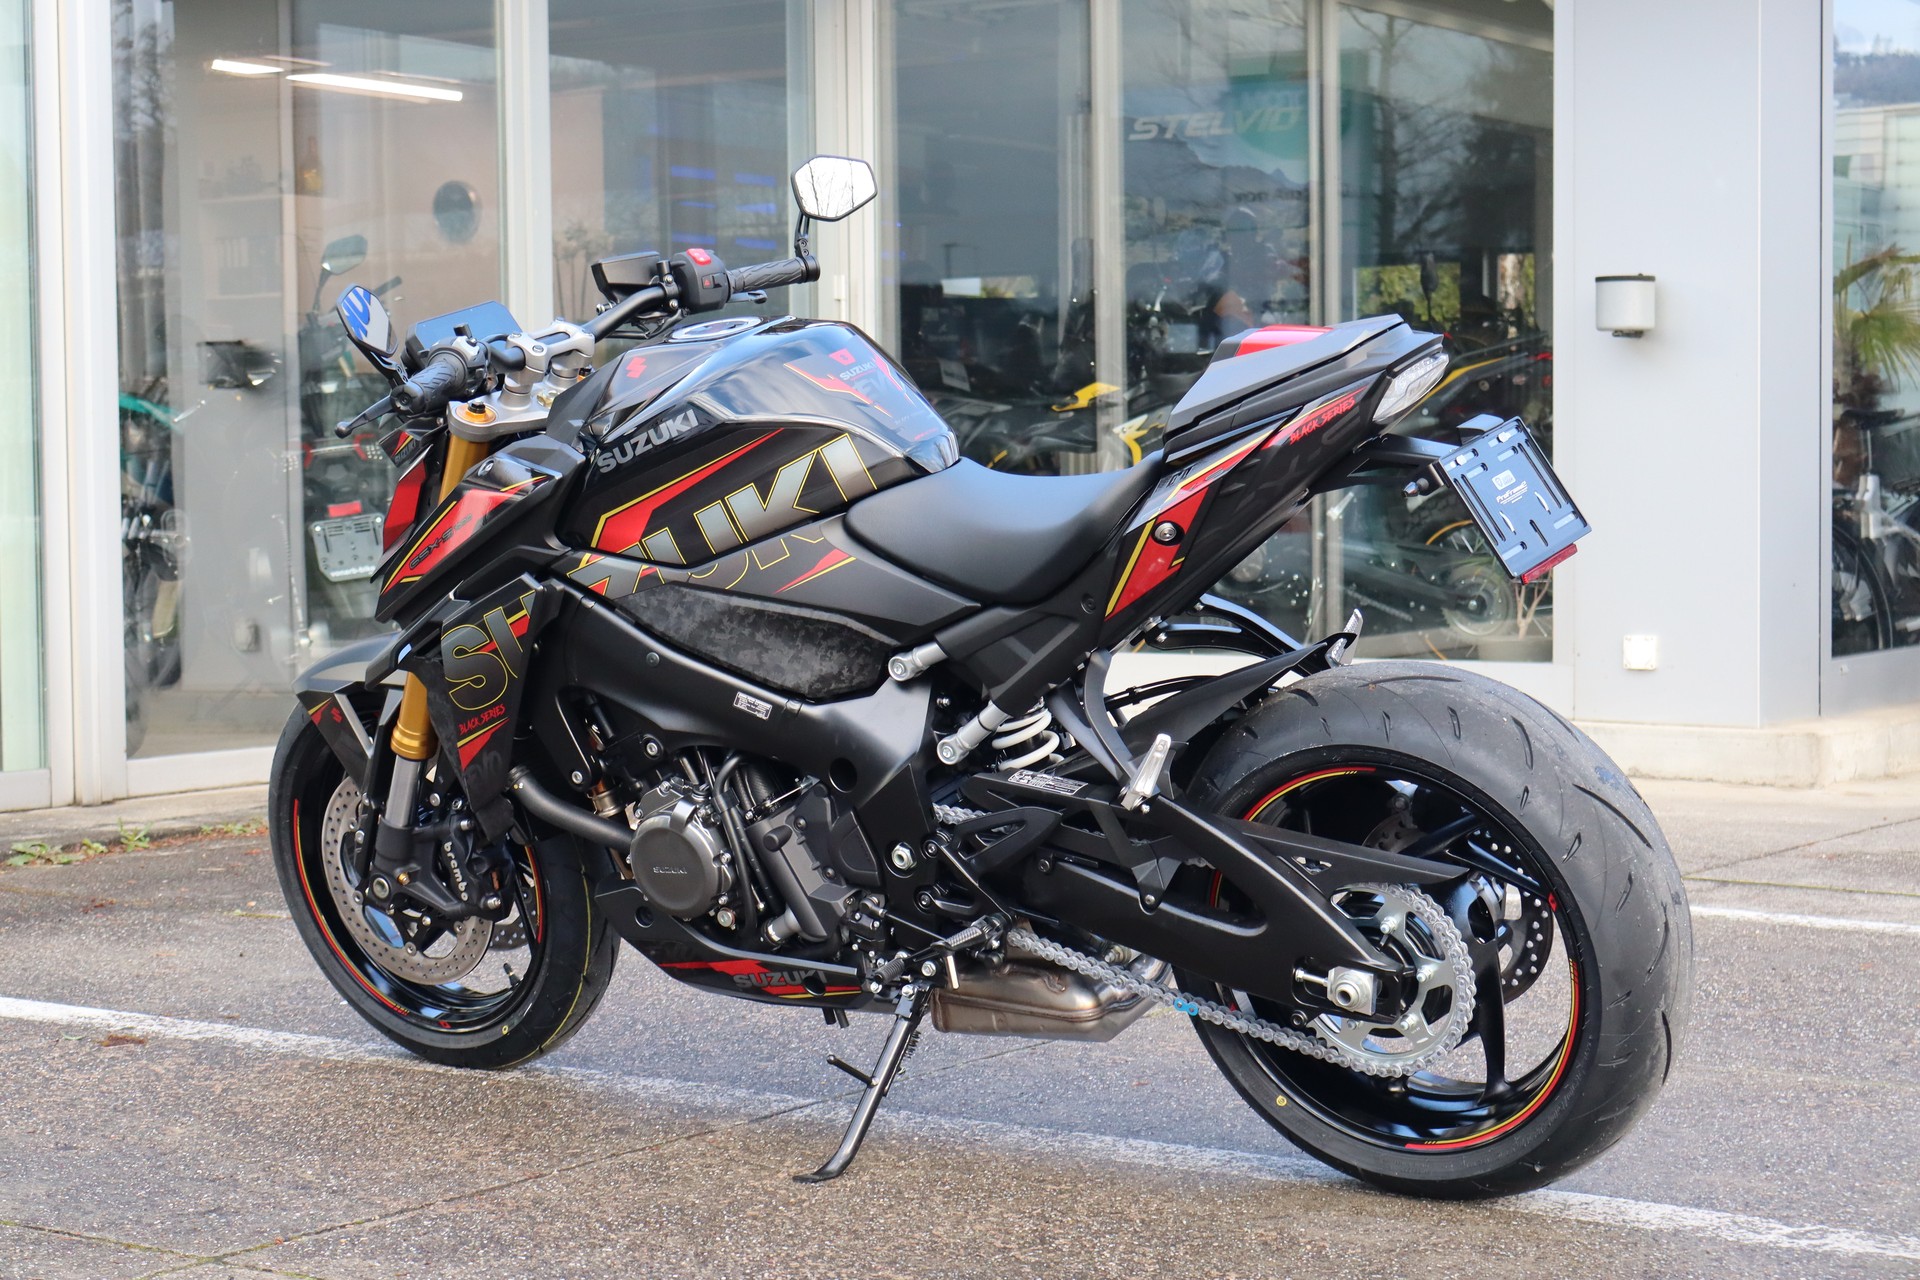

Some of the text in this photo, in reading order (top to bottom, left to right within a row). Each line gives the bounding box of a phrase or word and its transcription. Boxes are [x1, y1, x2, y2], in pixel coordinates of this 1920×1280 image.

[597, 408, 699, 474] SUZUKI
[1290, 397, 1356, 446] BLACK SERIES
[458, 703, 506, 736] BLACK SERIES
[443, 841, 468, 902] brembo
